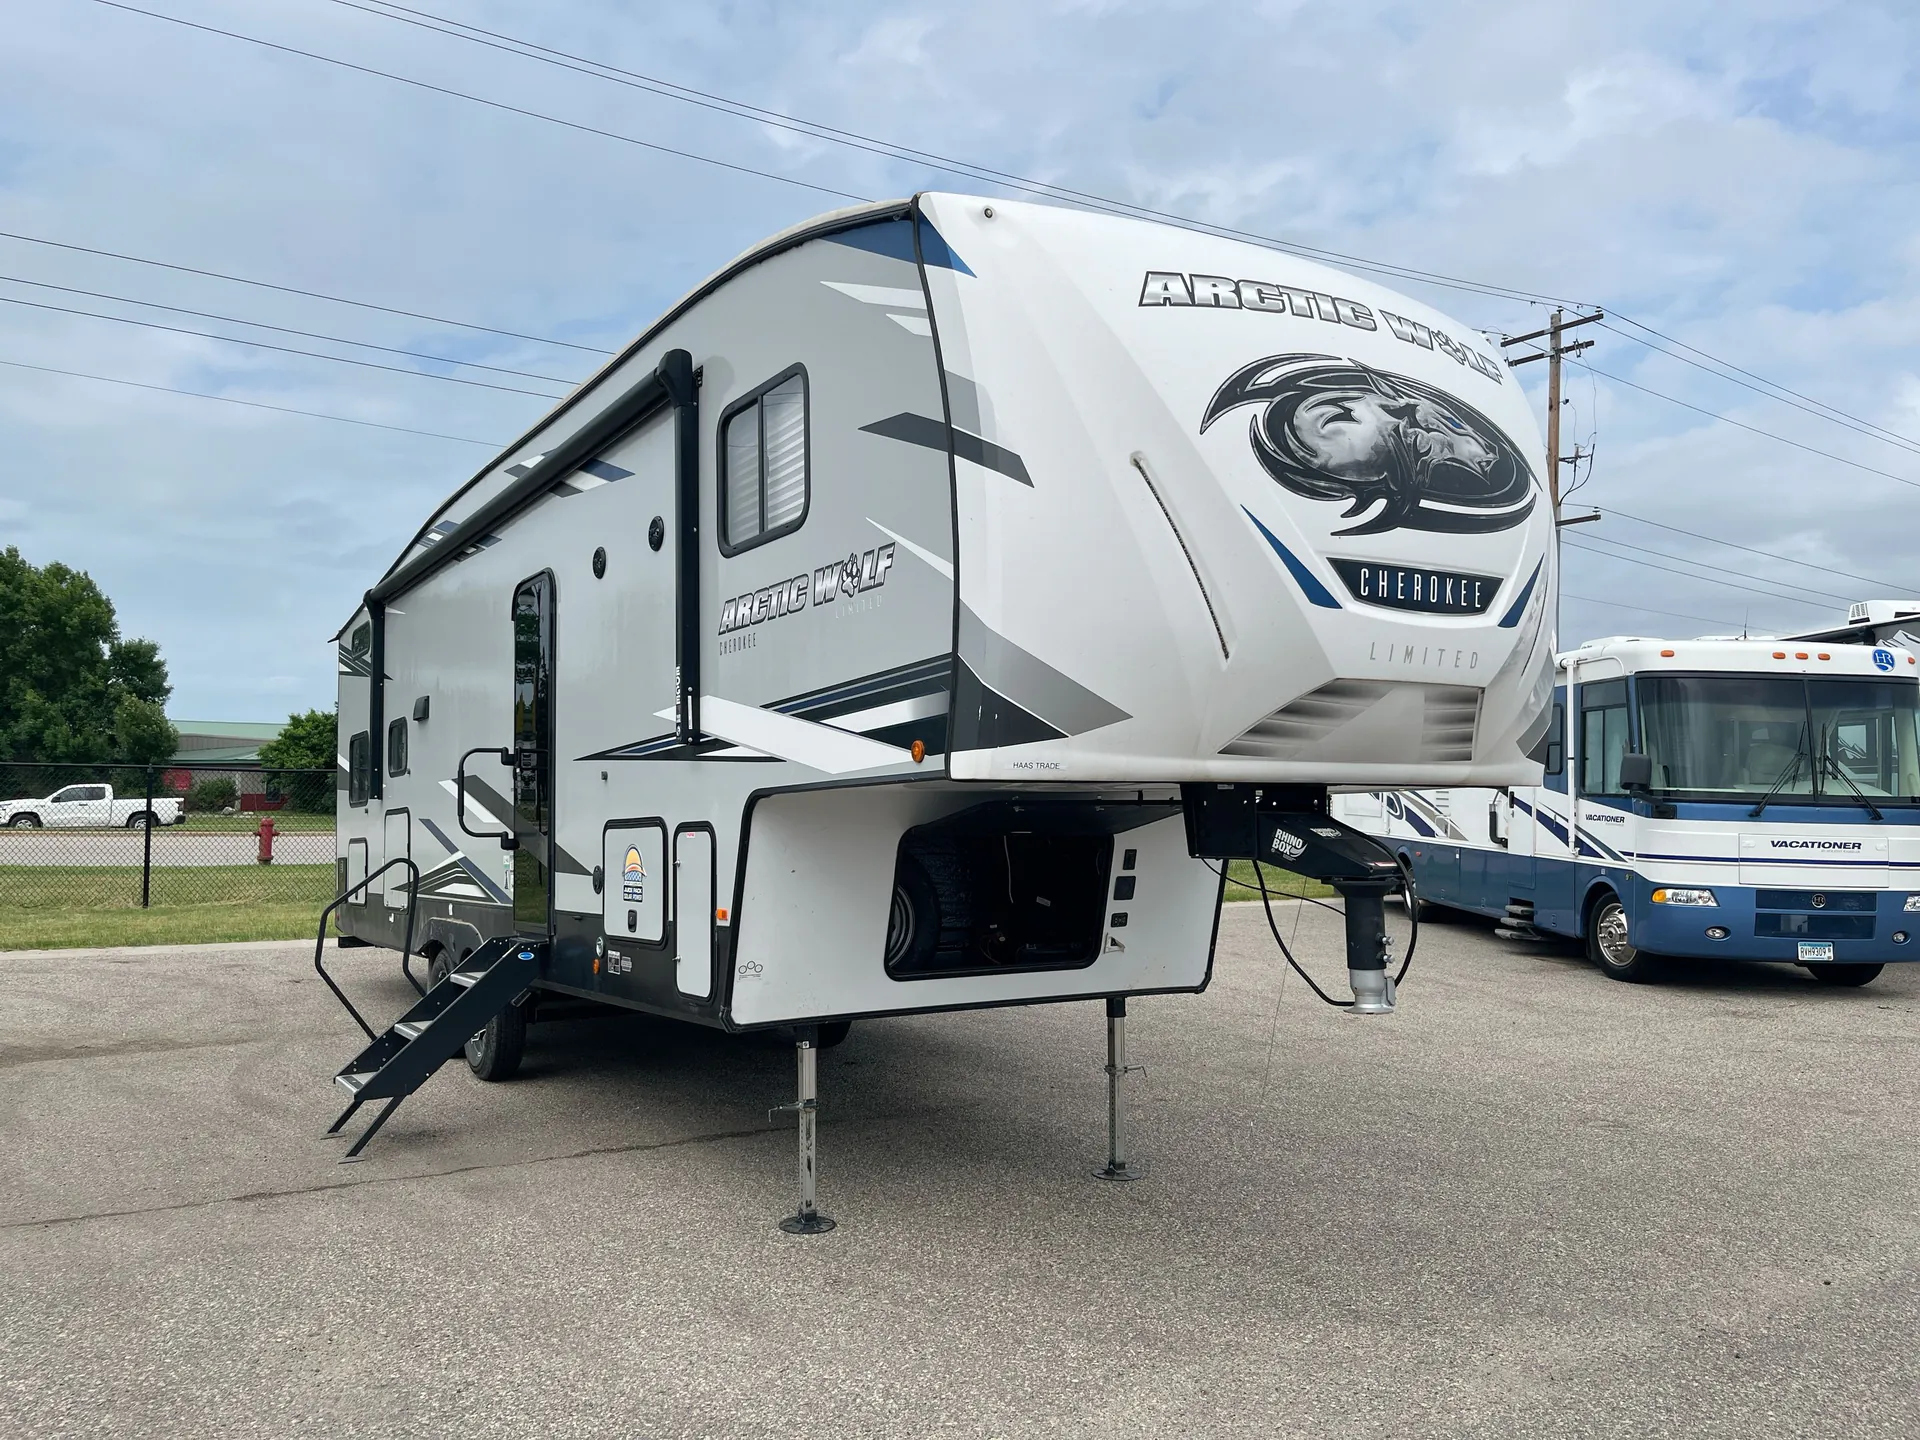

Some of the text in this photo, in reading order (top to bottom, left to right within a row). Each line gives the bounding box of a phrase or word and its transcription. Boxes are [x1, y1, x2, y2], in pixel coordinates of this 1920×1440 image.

[1138, 270, 1377, 332] ARCTIC
[1360, 567, 1482, 608] CHEROKEE
[717, 573, 810, 636] ARCTIC
[835, 594, 883, 619] LIMITED
[719, 632, 756, 656] CHEROKEE
[1369, 641, 1479, 670] LIMITED
[1012, 762, 1061, 770] HAAS TRADE
[1585, 813, 1625, 824] VACATIONER
[1271, 837, 1292, 856] BOX
[1275, 828, 1303, 849] RHINO
[1770, 840, 1862, 850] VACATIONER
